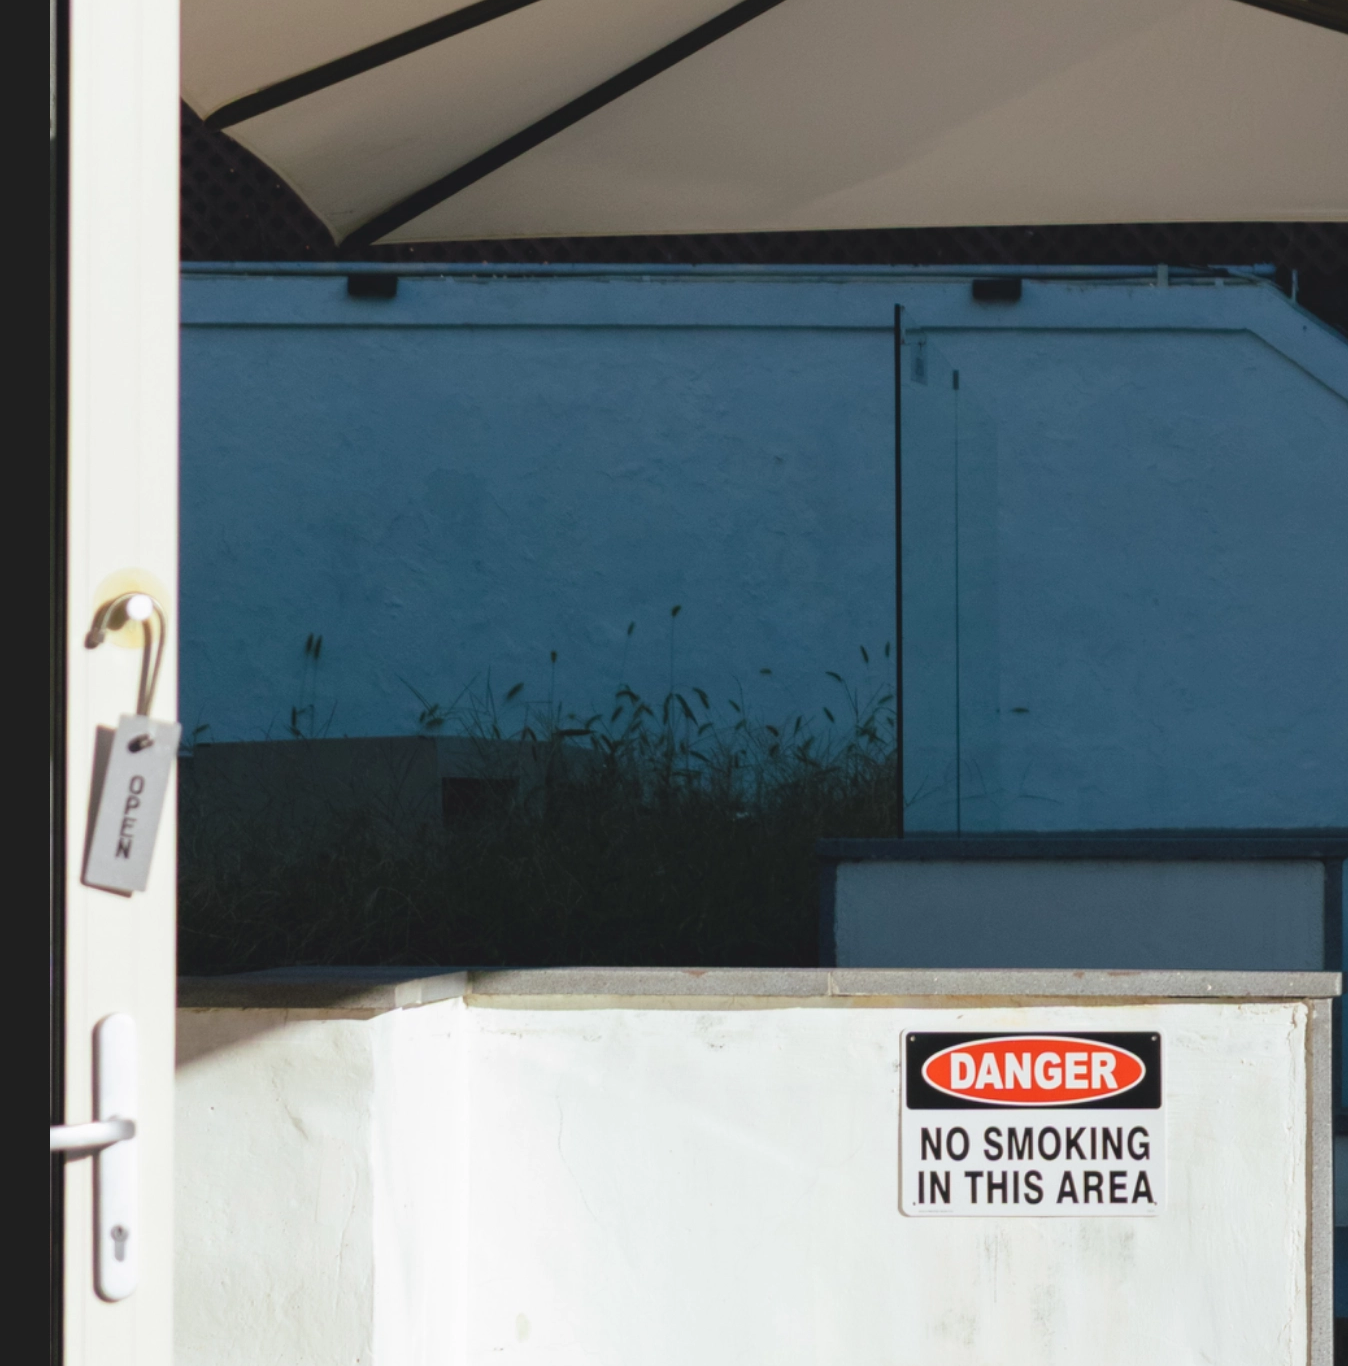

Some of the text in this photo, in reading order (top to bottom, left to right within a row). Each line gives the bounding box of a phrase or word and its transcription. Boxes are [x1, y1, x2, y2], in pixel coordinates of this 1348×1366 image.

[115, 776, 145, 860] OPEN
[950, 1052, 1118, 1090] DANGER
[921, 1126, 1150, 1161] NO SMOKING
[918, 1169, 1154, 1204] IN THIS AREA
